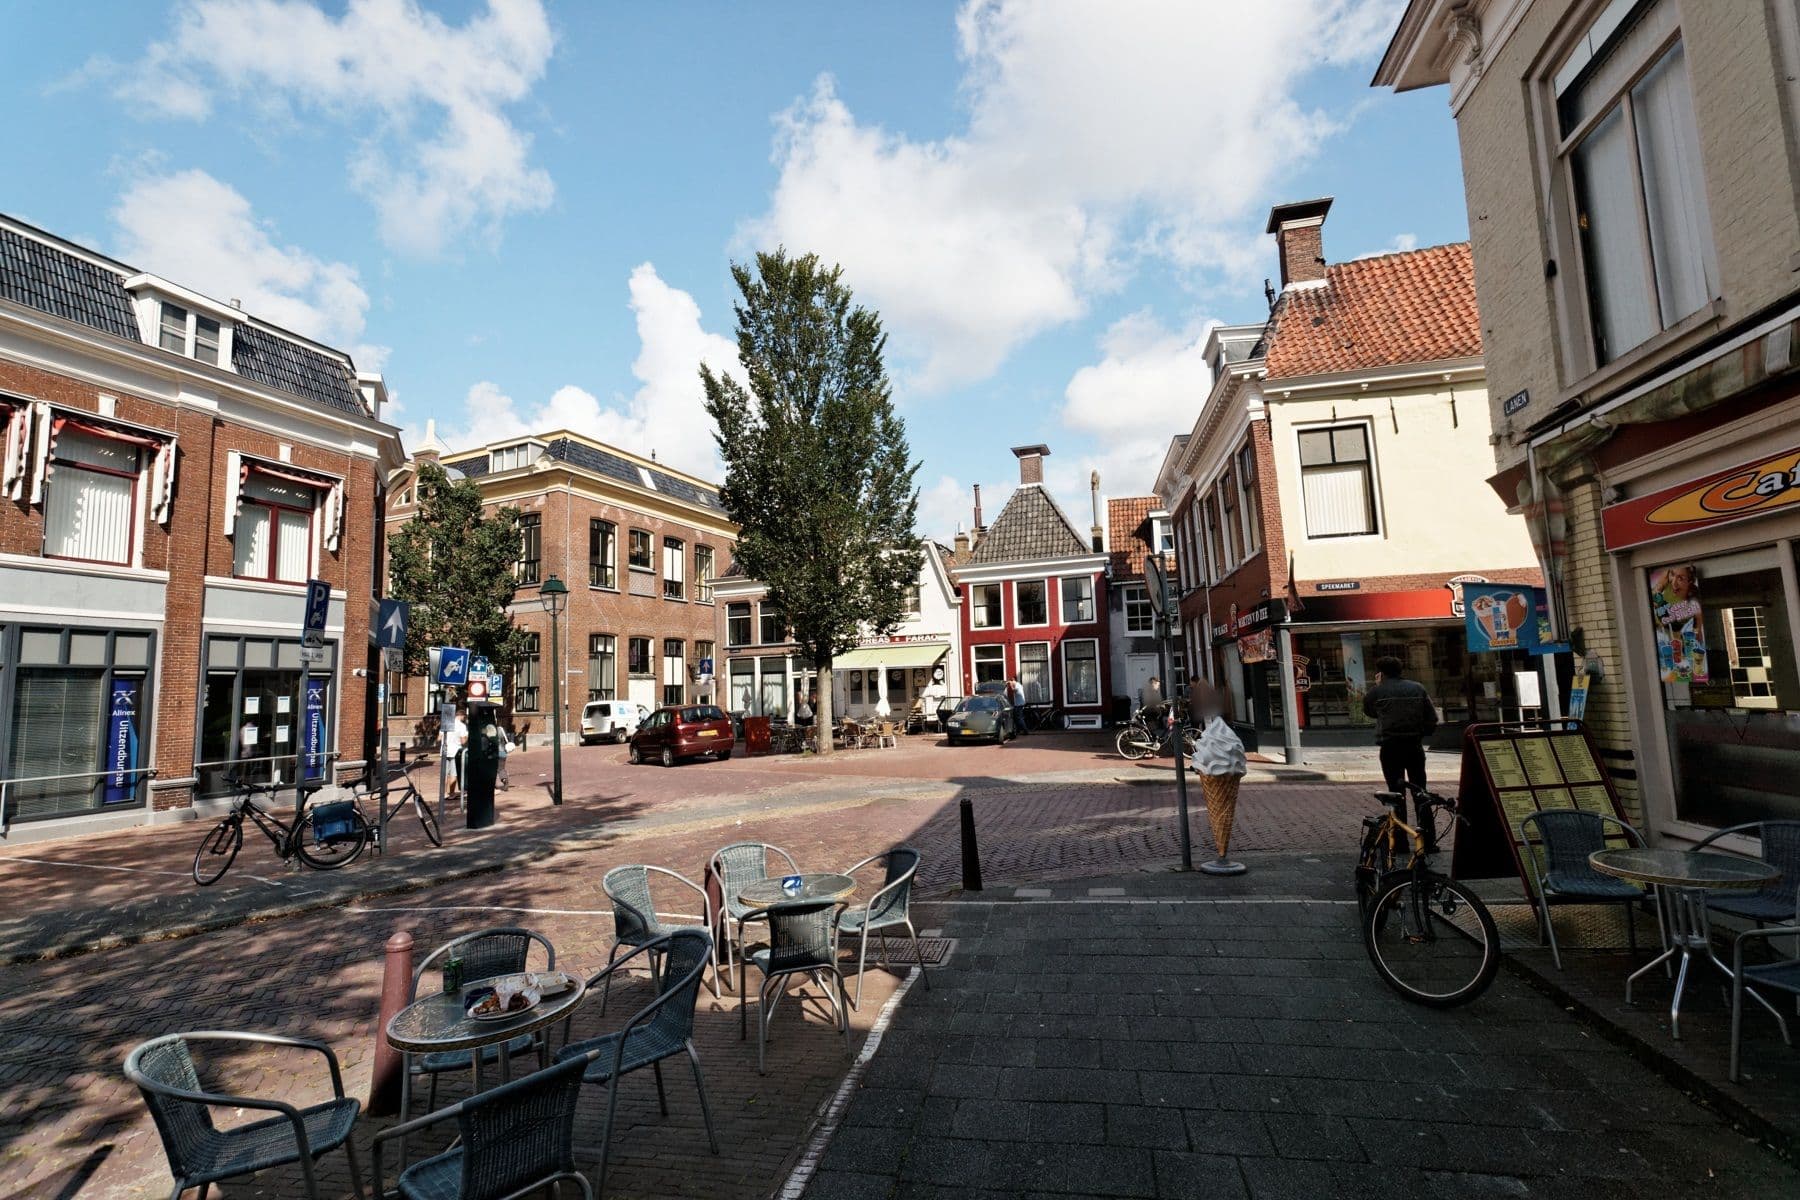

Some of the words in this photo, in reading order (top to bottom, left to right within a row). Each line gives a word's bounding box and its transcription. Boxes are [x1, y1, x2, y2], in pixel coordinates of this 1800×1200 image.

[1321, 582, 1355, 590] SPEKMARKT
[313, 585, 326, 609] P
[112, 708, 136, 717] Alinex
